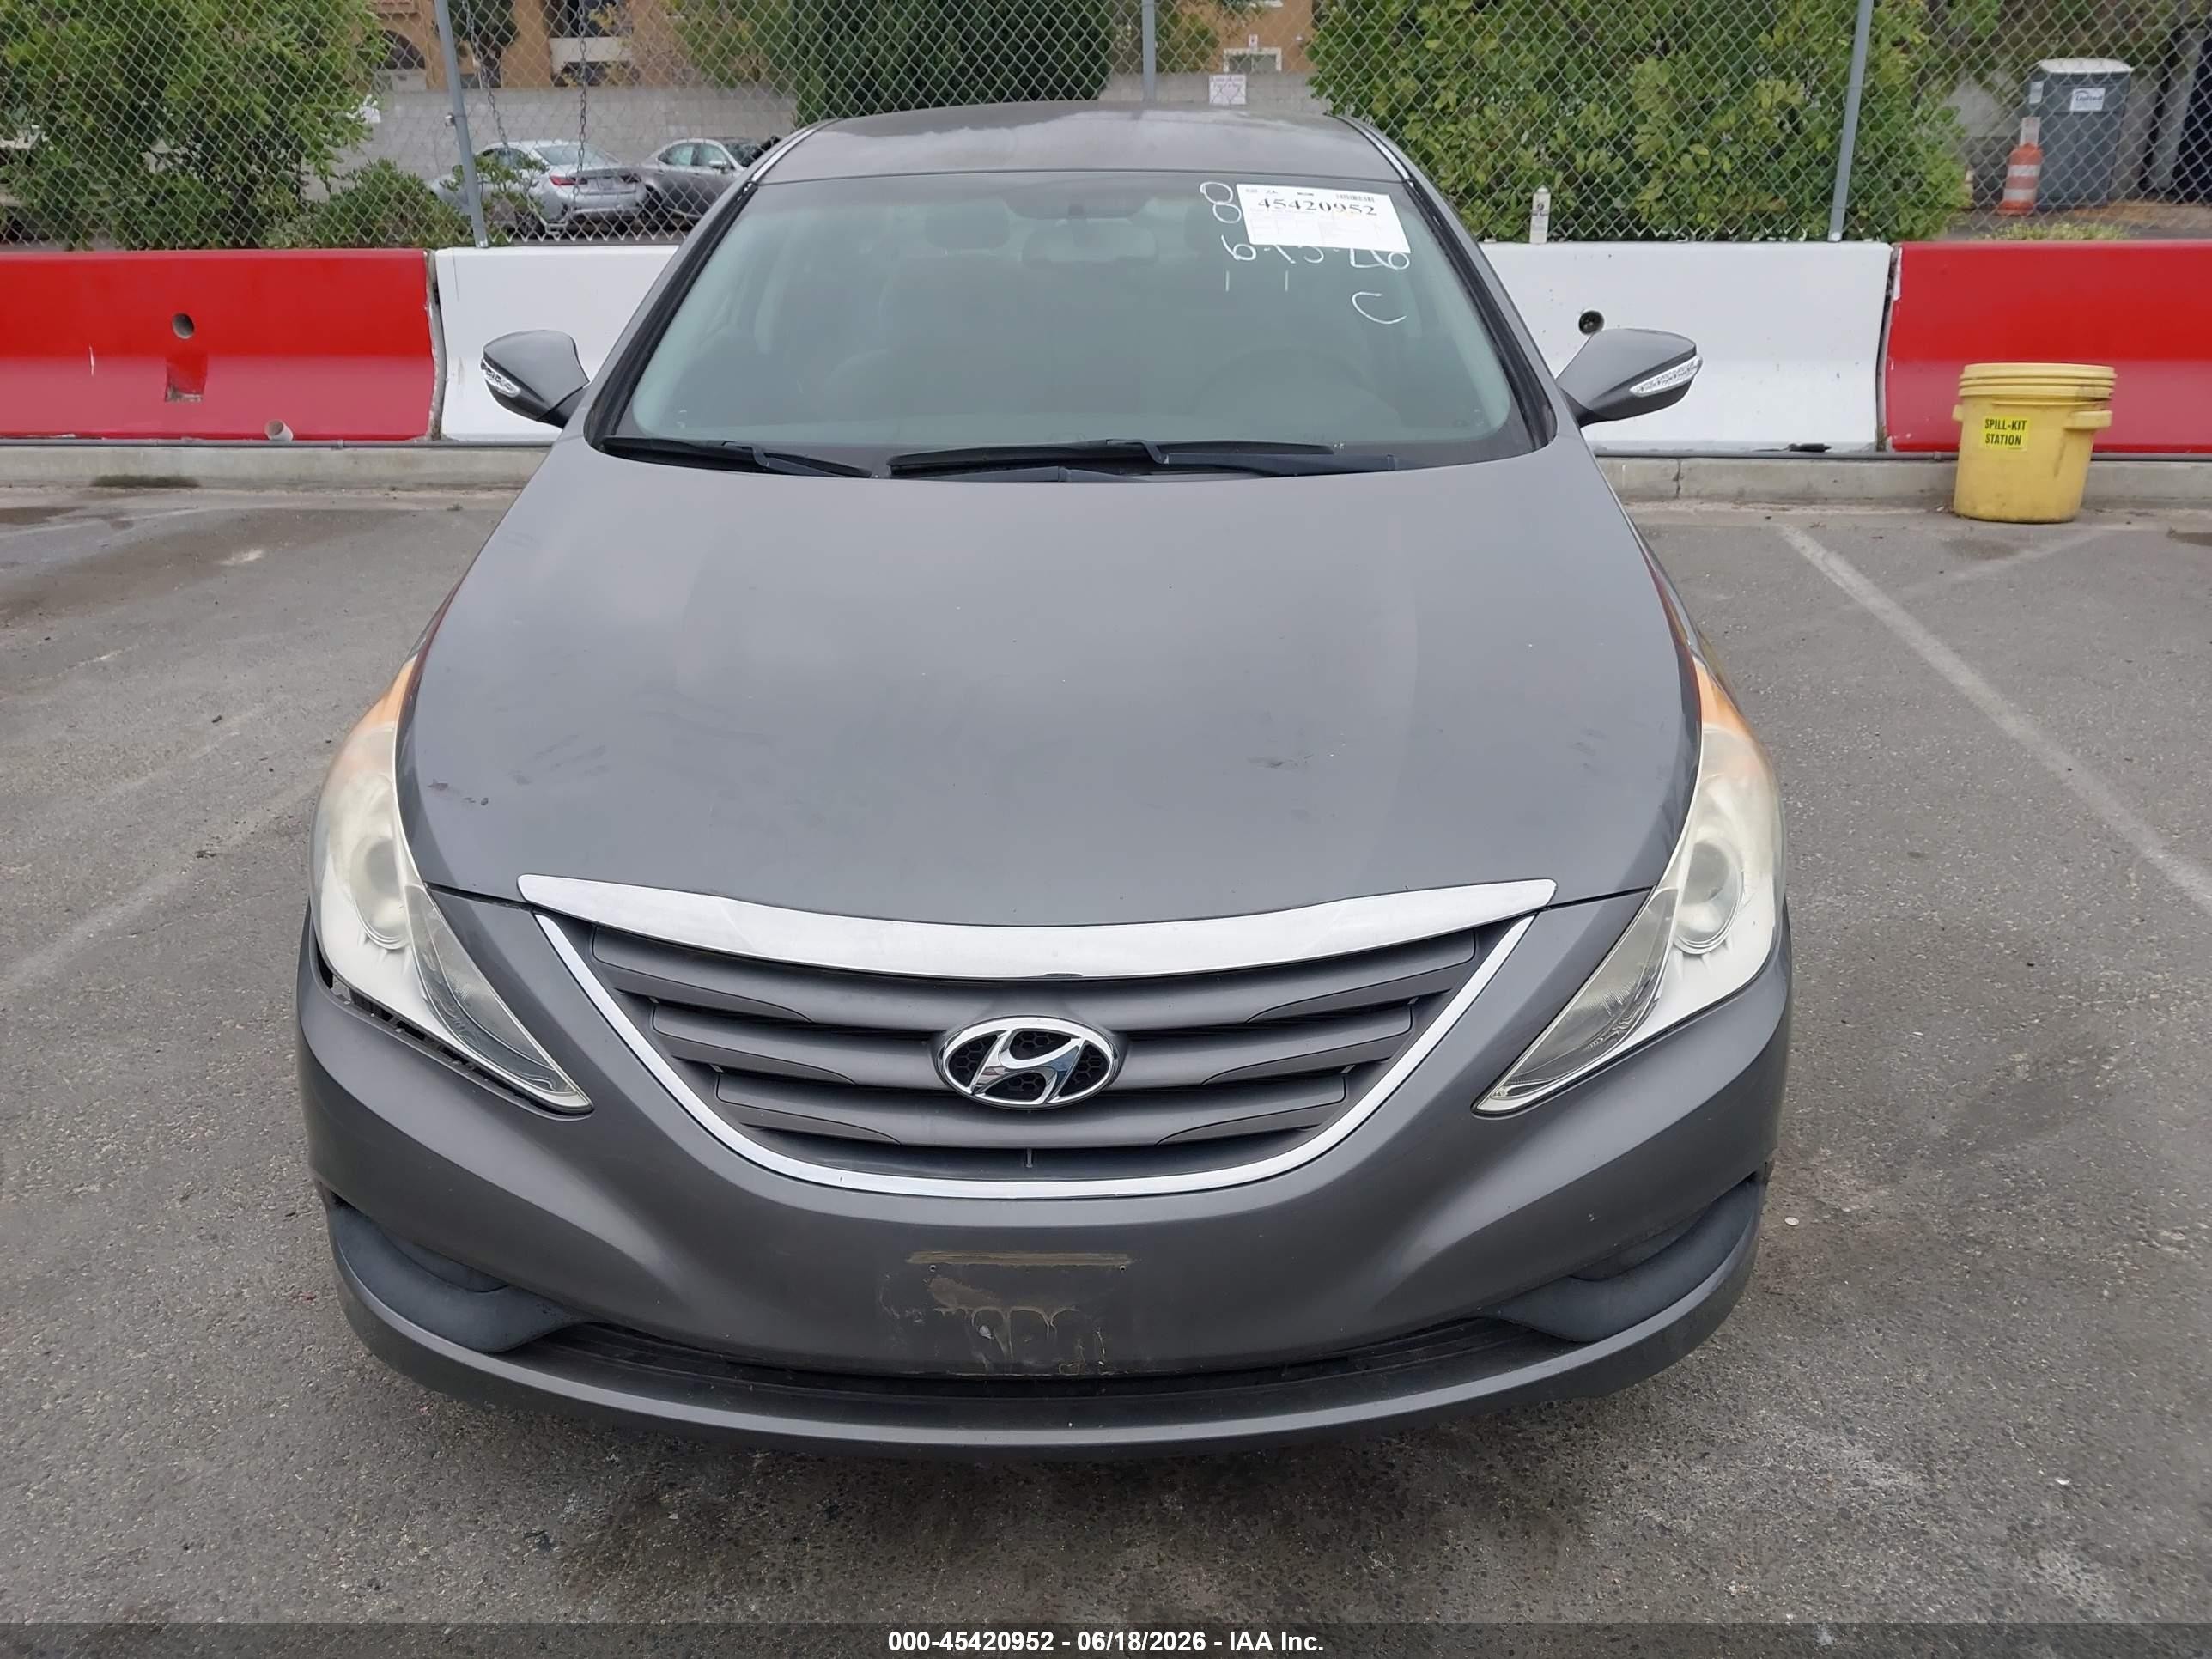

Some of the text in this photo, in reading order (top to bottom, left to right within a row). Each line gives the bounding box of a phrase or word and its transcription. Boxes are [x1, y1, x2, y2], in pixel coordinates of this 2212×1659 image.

[1258, 198, 1377, 216] 45420952
[1984, 418, 2027, 431] SPILL-KIT
[1984, 433, 2021, 446] STATION
